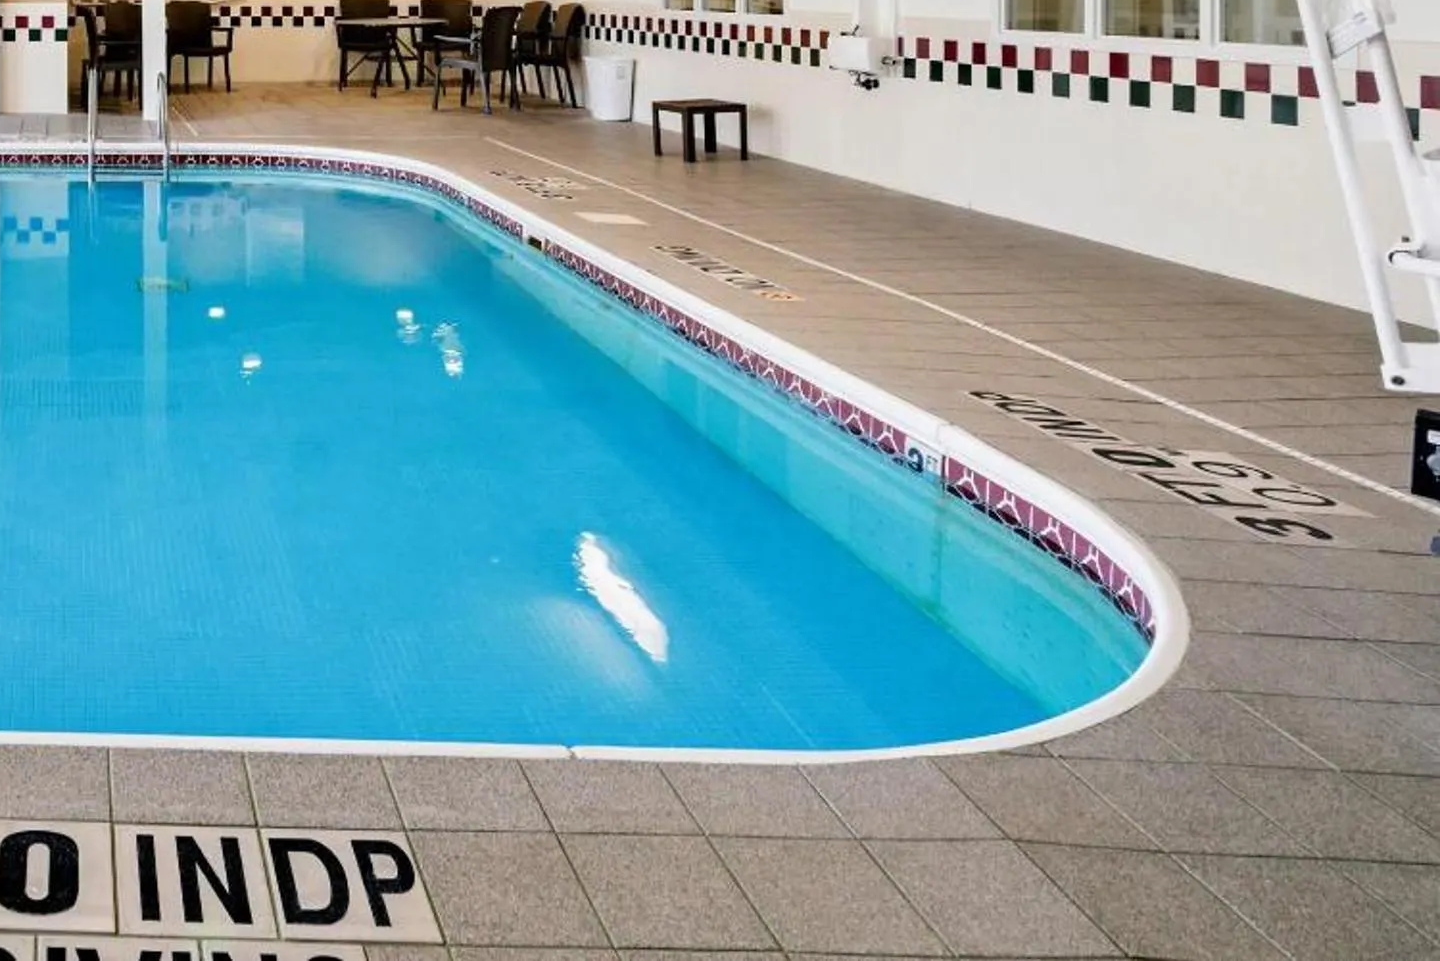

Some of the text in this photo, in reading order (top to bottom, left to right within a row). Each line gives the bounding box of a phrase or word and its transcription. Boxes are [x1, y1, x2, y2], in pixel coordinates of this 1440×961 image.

[1023, 416, 1122, 441] IN
[1092, 447, 1176, 469] 0
[1139, 472, 1268, 509] FT
[1235, 516, 1335, 540] 3
[136, 834, 253, 925] IN
[268, 837, 415, 927] DP
